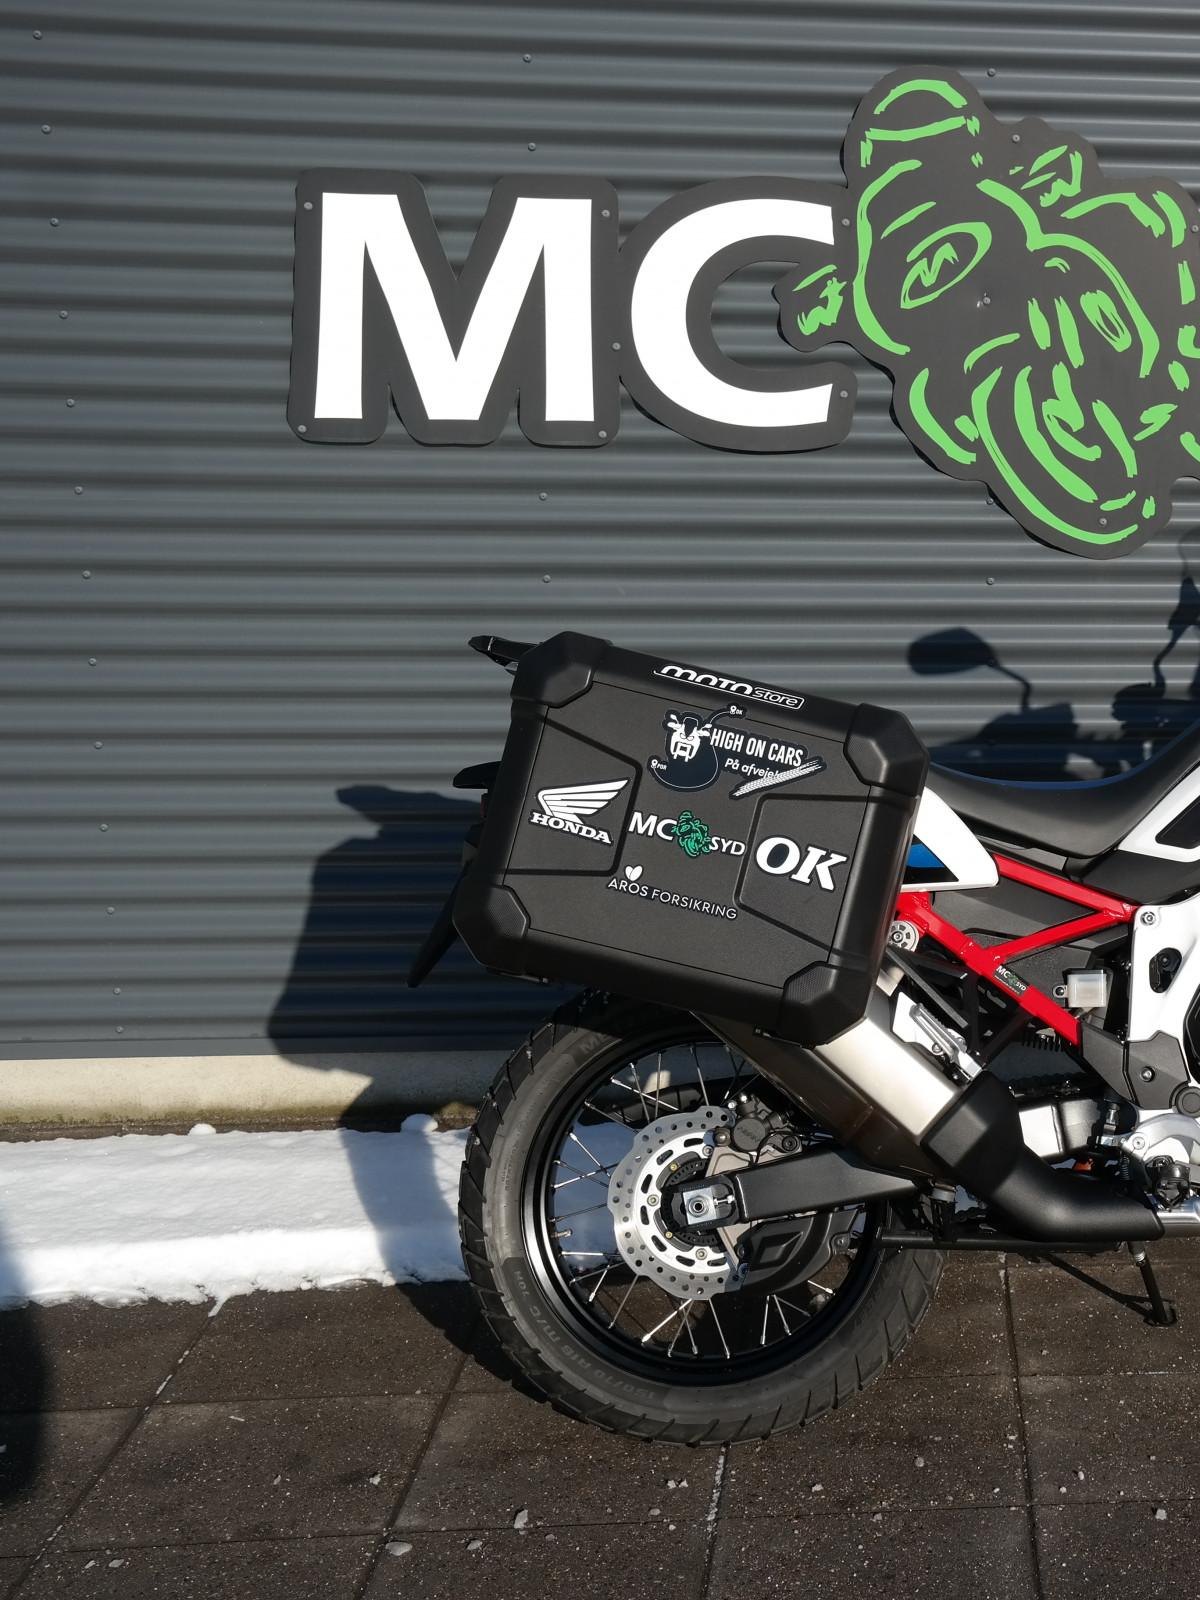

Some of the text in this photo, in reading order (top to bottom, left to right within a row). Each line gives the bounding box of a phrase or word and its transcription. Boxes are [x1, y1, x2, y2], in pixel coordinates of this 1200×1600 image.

[314, 192, 835, 429] MC
[710, 728, 804, 767] HIGH ON CARS
[724, 757, 740, 770] På
[530, 811, 612, 844] HONDA
[628, 811, 746, 856] MC SYD
[755, 836, 848, 891] OK
[607, 878, 737, 919] AROS FORSIKRING
[996, 965, 1012, 979] MC
